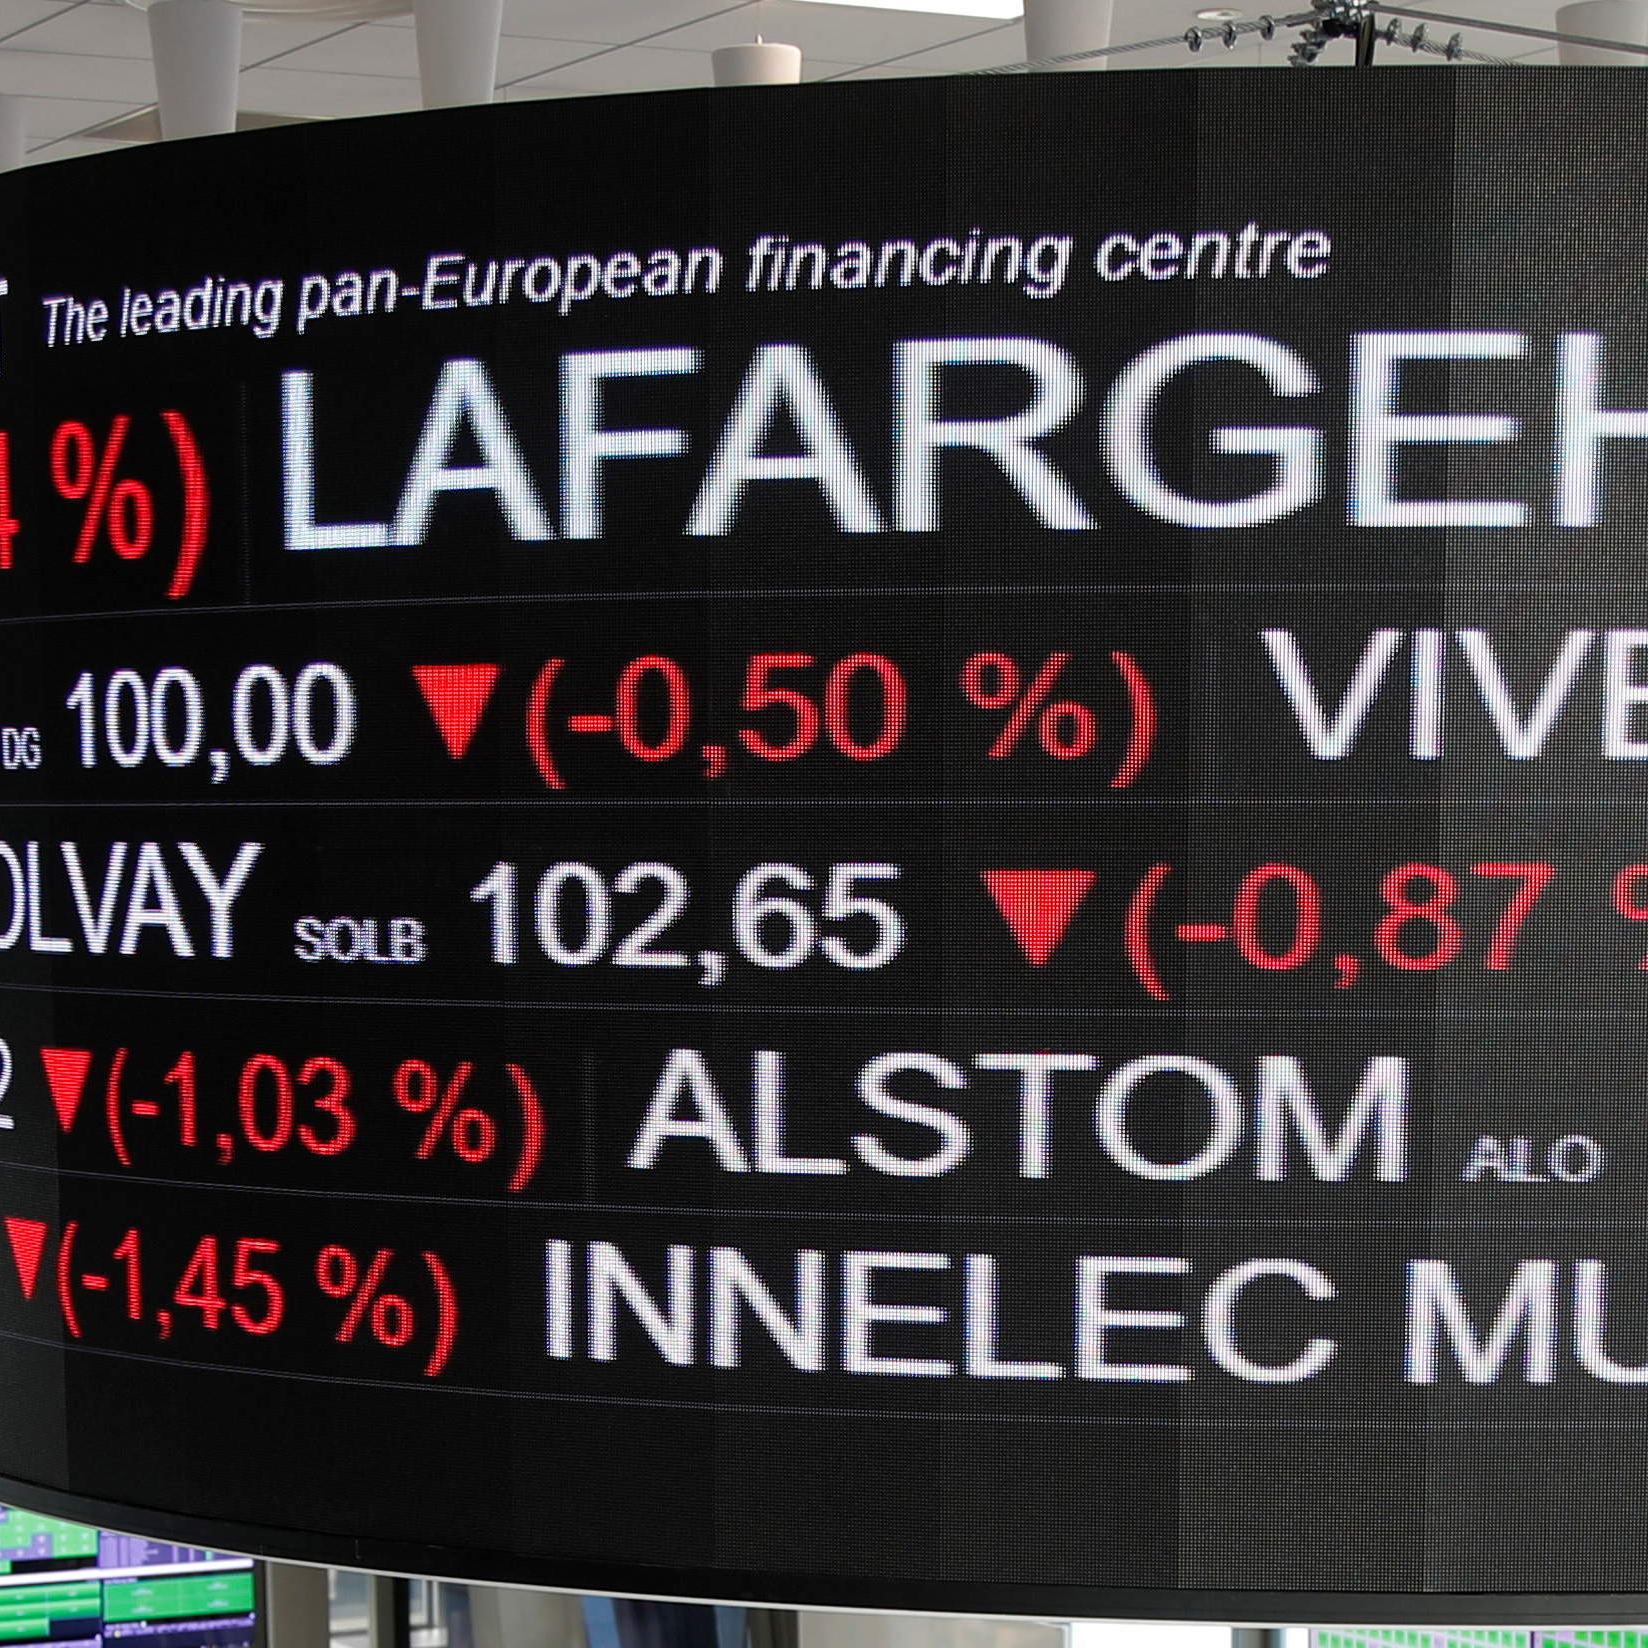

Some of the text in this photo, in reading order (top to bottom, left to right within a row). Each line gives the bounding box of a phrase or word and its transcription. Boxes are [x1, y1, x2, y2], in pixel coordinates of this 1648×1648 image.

[43, 296, 109, 347] The
[120, 277, 284, 339] leading
[297, 247, 723, 334] pan-European
[746, 228, 1073, 299] financing
[1096, 222, 1331, 281] centre
[51, 411, 208, 599] %)
[1, 726, 41, 770] DG
[66, 662, 355, 784] 100,00
[527, 652, 906, 789] (-0,50
[962, 651, 1157, 788] %)
[294, 916, 425, 964] SOLB
[471, 862, 904, 986] 102,65
[1125, 861, 1559, 1000] (-0,87
[107, 1048, 356, 1165] (-1,03
[394, 1059, 545, 1191] %)
[628, 1049, 1409, 1182] ALSTOM
[1462, 1135, 1604, 1182] ALO
[58, 1222, 284, 1337] (-1,45
[316, 1245, 458, 1376] %)
[546, 1239, 1338, 1384] INNELEC
